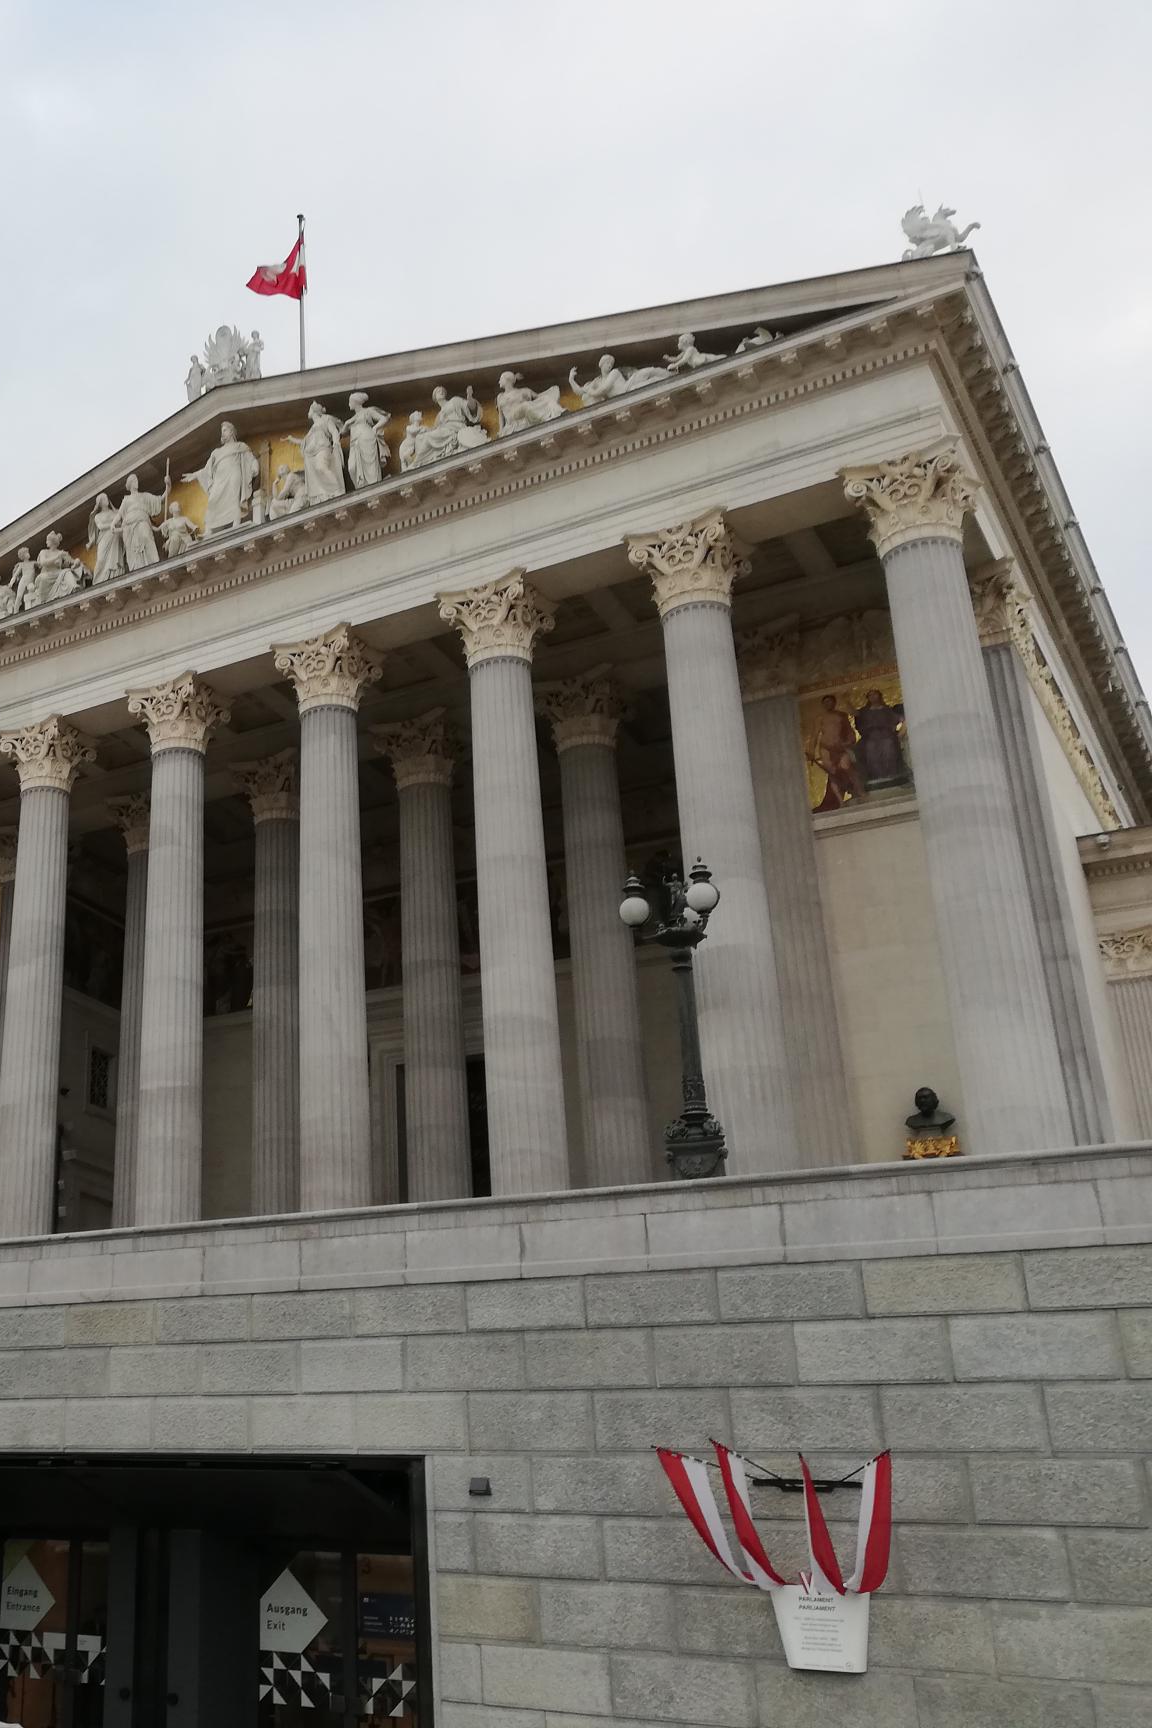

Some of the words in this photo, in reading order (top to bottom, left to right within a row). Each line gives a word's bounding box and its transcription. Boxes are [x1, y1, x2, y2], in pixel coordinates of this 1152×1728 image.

[7, 1585, 38, 1598] Eingang
[7, 1601, 40, 1612] Entrance
[266, 1603, 308, 1616] Ausgang
[798, 1604, 836, 1612] PARLIAMENT
[266, 1620, 286, 1631] Exit
